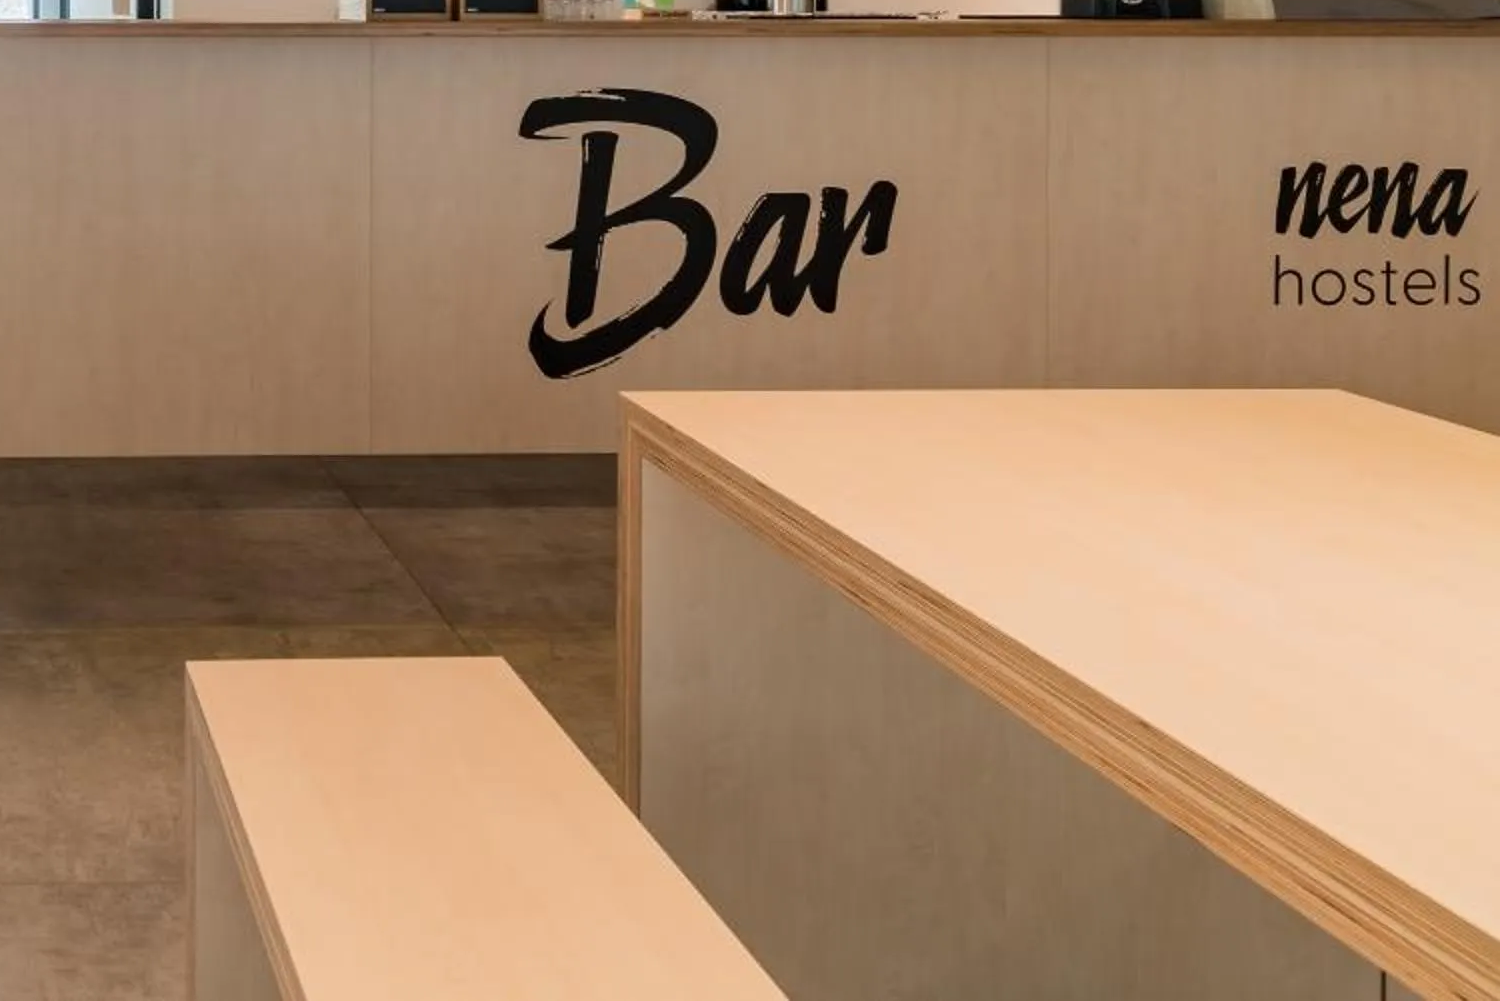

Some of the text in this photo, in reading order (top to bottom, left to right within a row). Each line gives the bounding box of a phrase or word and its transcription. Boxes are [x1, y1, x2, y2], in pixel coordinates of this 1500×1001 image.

[518, 88, 899, 380] Bar
[1274, 160, 1480, 240] nena
[1273, 254, 1482, 307] hostels
